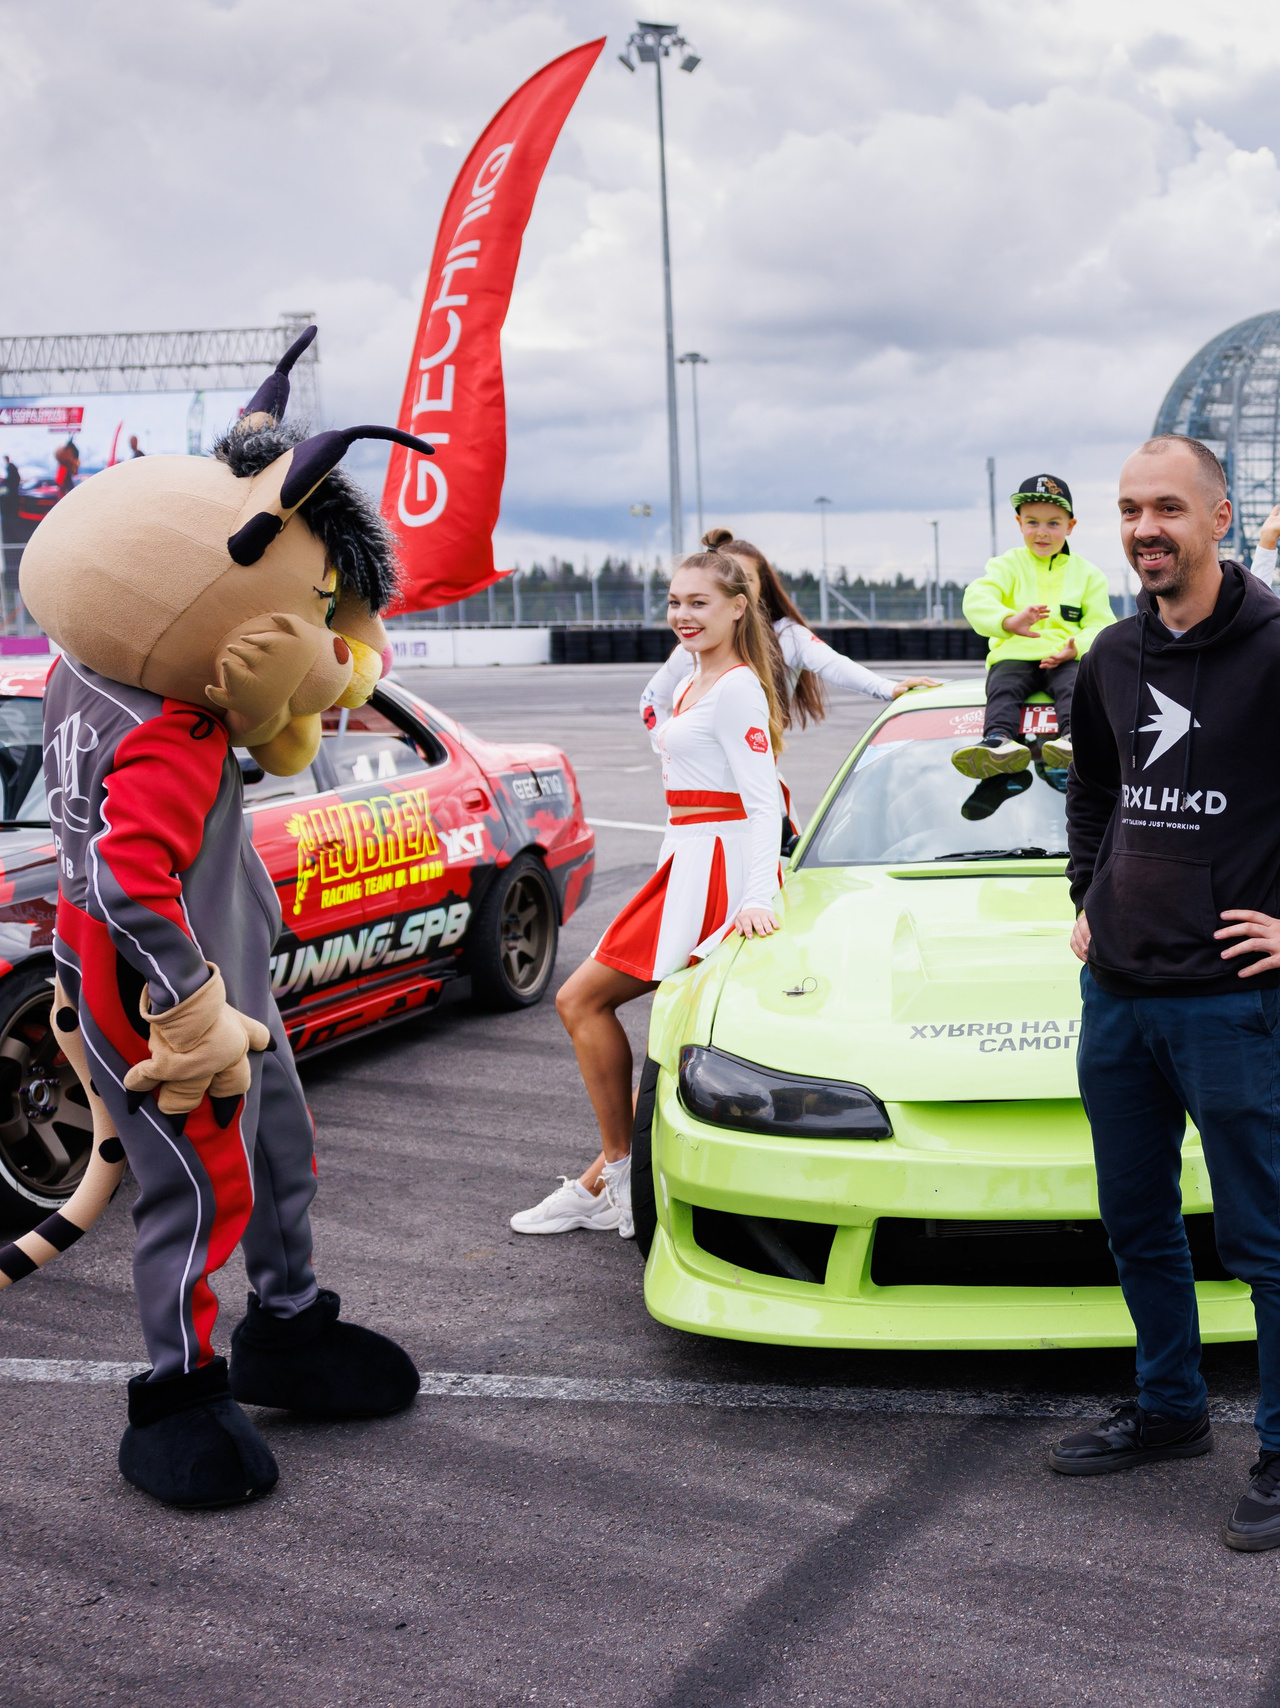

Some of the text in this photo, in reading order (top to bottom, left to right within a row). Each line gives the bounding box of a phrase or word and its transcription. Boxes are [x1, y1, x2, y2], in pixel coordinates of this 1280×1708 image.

[308, 788, 439, 884] LUBREX
[1148, 821, 1165, 829] JUST
[1166, 822, 1200, 831] WORKING
[321, 881, 362, 909] RACING
[364, 872, 394, 896] TEAM
[1021, 1020, 1060, 1034] НА
